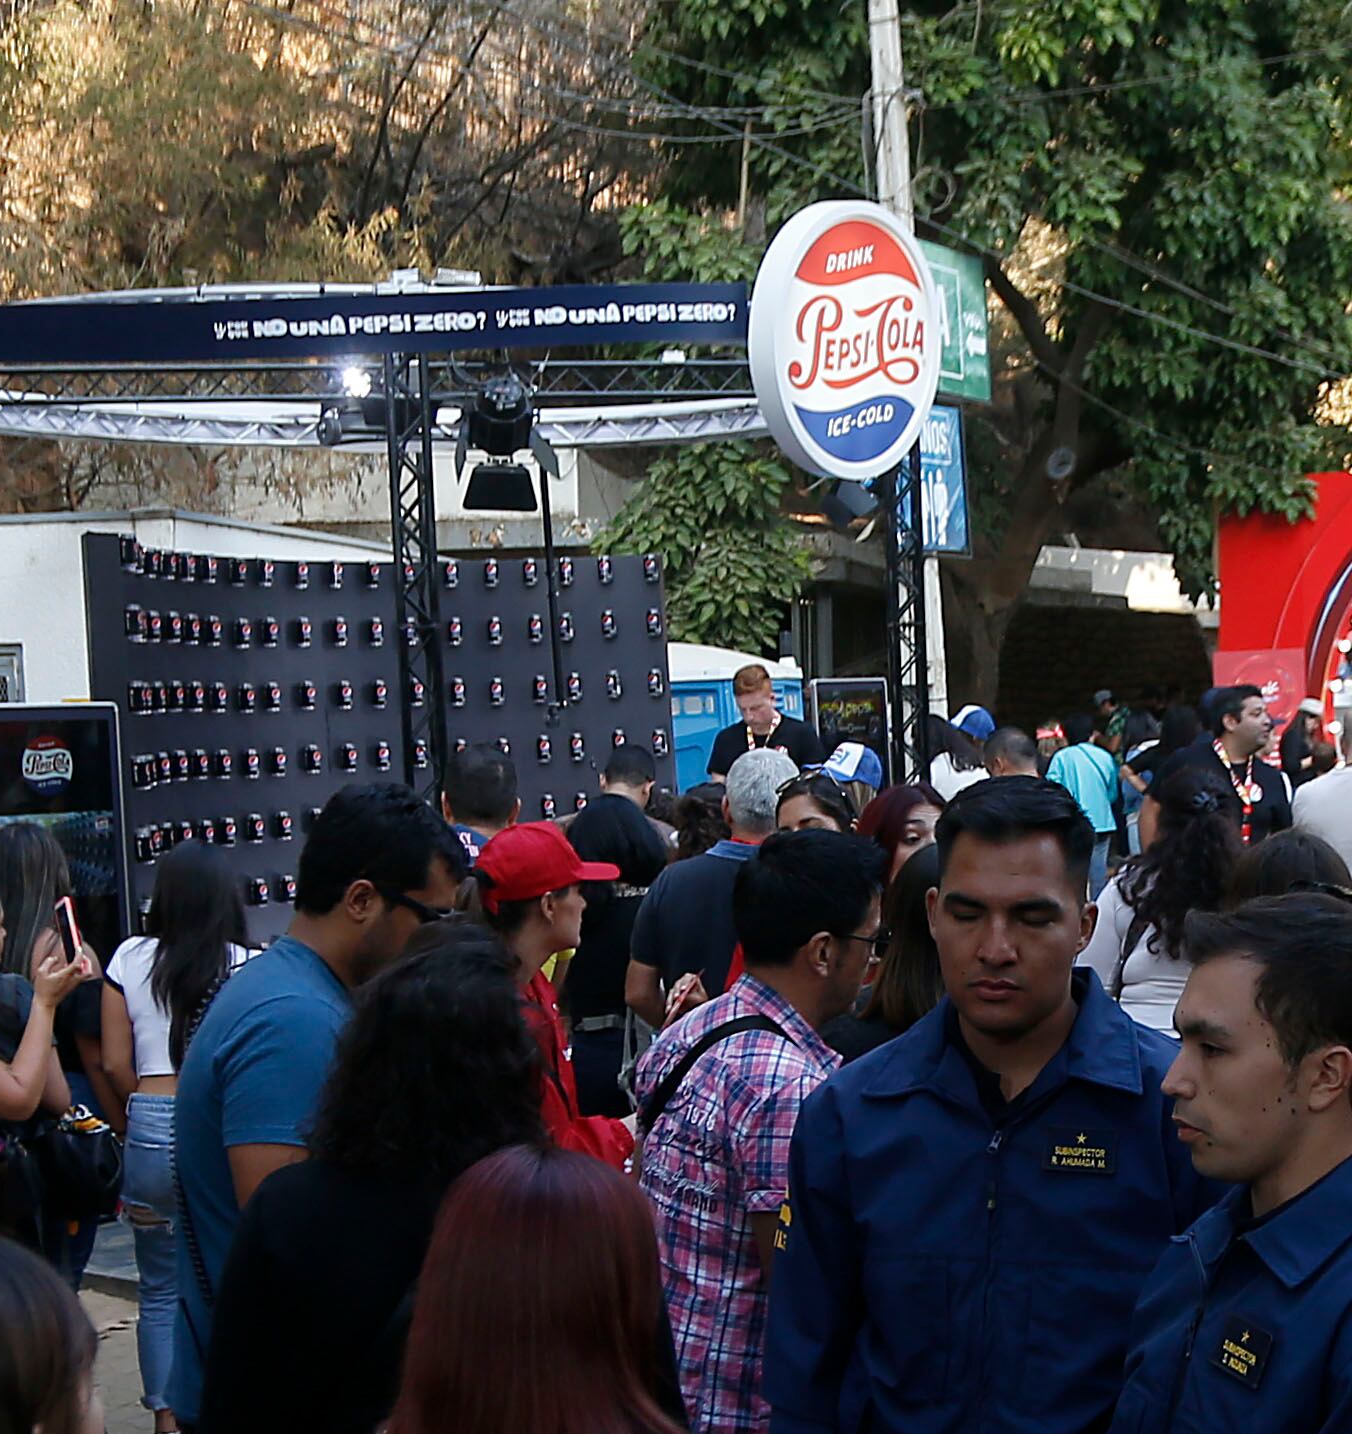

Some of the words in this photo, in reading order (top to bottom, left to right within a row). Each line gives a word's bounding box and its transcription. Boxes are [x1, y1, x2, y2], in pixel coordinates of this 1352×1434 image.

[825, 246, 874, 274] DRINK
[253, 318, 288, 338] NO
[289, 314, 346, 337] UNA
[348, 313, 411, 335] PEPSI
[414, 311, 487, 333] ZERO?
[534, 305, 567, 326] NO
[569, 302, 621, 325] UNA
[623, 303, 676, 323] PEPSI
[678, 303, 736, 323] ZERO?
[827, 403, 894, 438] ICE-COLD
